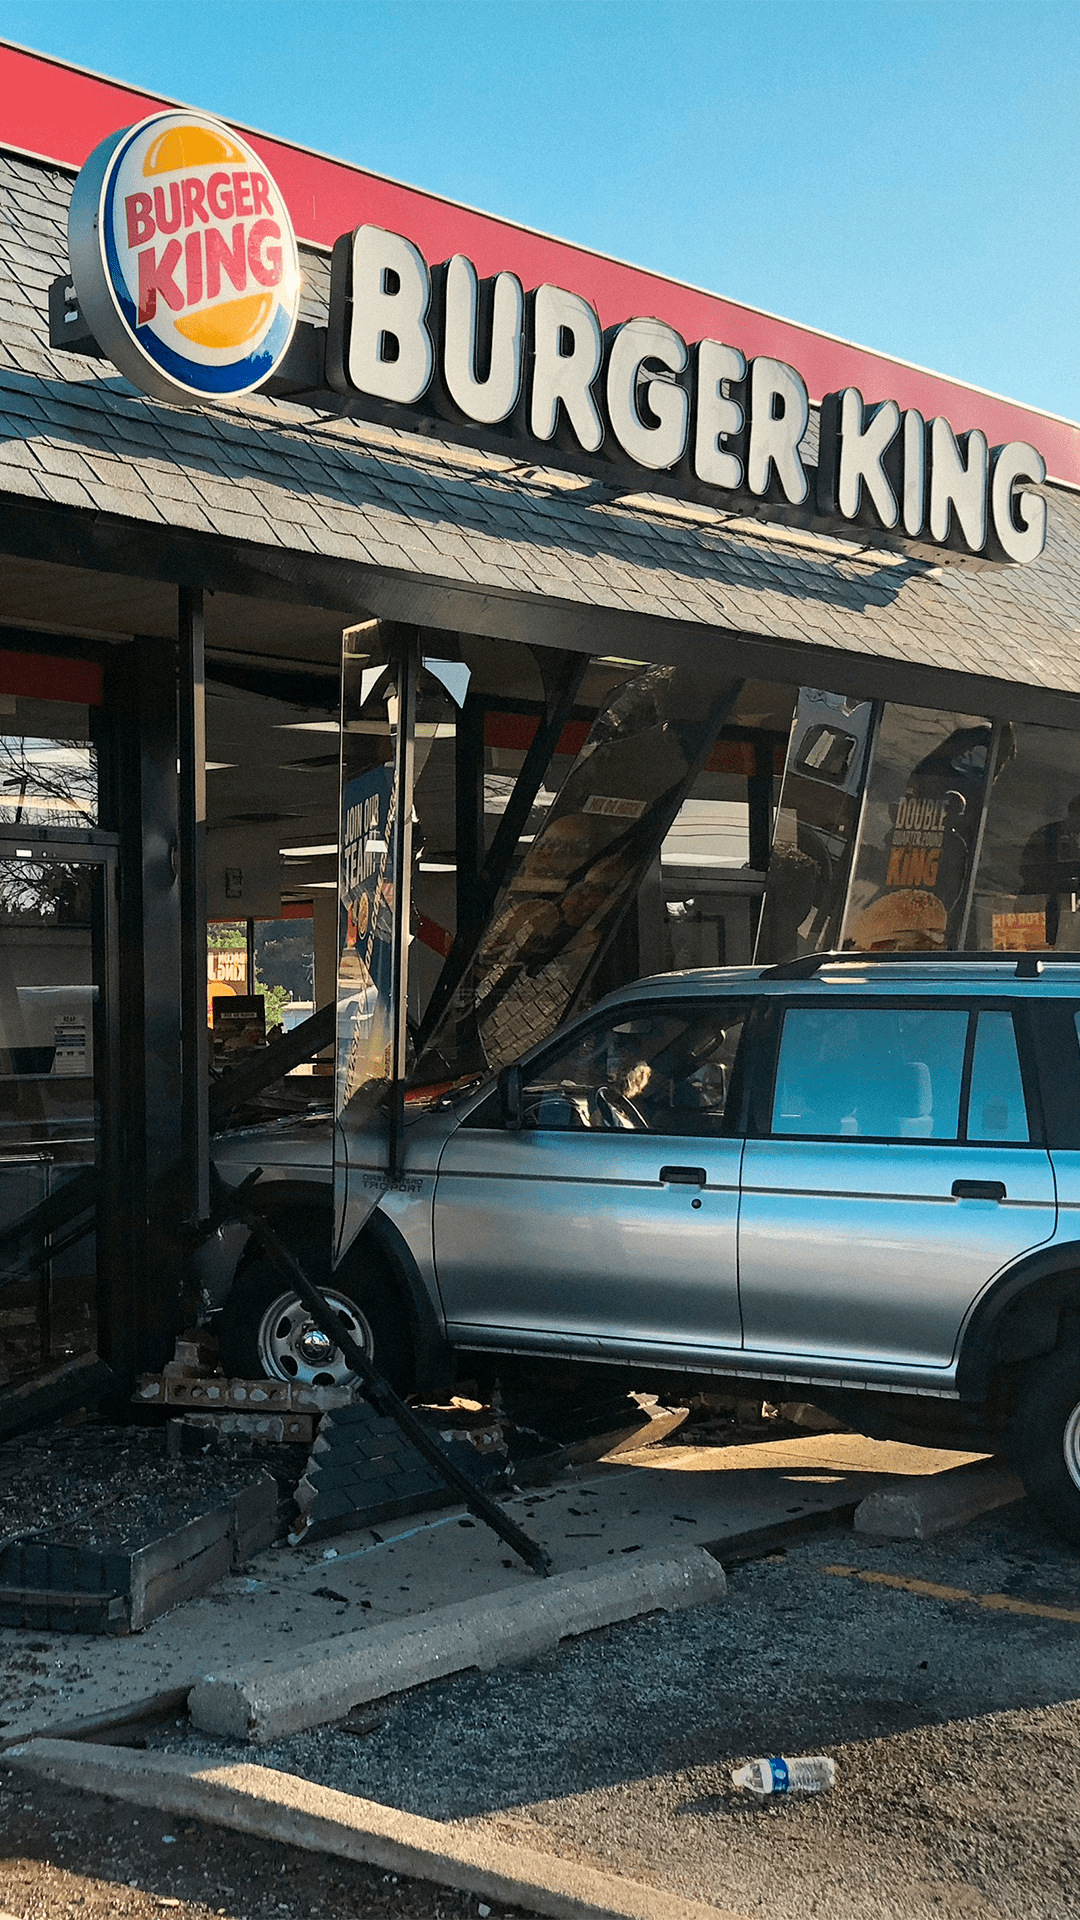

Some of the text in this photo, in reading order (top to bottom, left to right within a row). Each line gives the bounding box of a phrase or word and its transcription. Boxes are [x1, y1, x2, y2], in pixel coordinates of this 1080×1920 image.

[124, 171, 274, 249] BURGER
[136, 219, 283, 326] KING
[347, 223, 1047, 565] BURGER KING
[344, 792, 380, 846] JOIN OUR
[895, 797, 949, 831] DOUBLE
[886, 847, 942, 887] KING
